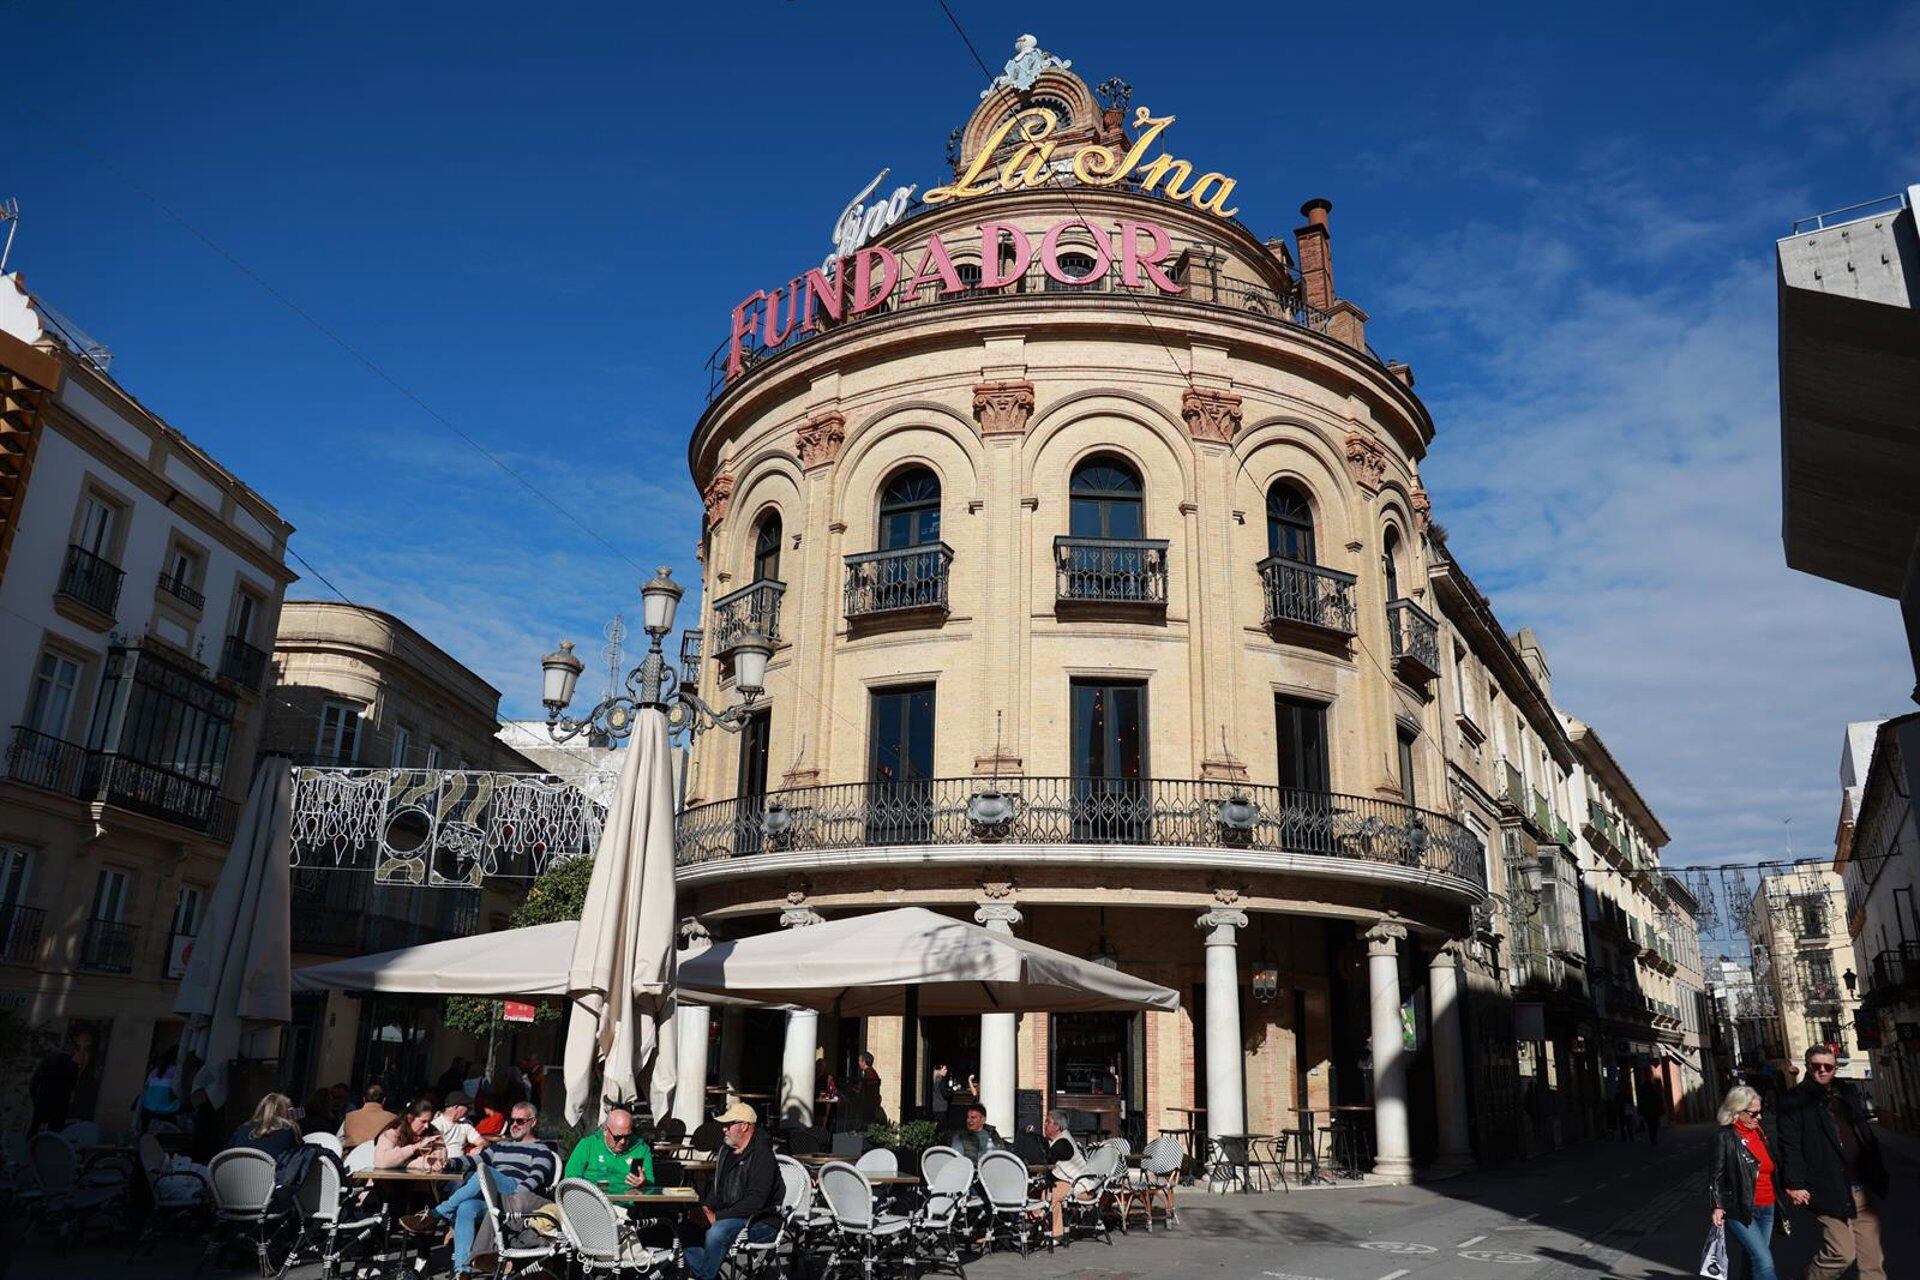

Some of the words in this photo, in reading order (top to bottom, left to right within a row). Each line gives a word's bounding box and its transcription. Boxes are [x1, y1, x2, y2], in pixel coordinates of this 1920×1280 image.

[922, 107, 1059, 204] La
[1073, 106, 1239, 218] Ina
[726, 219, 1186, 382] FUNDADOR
